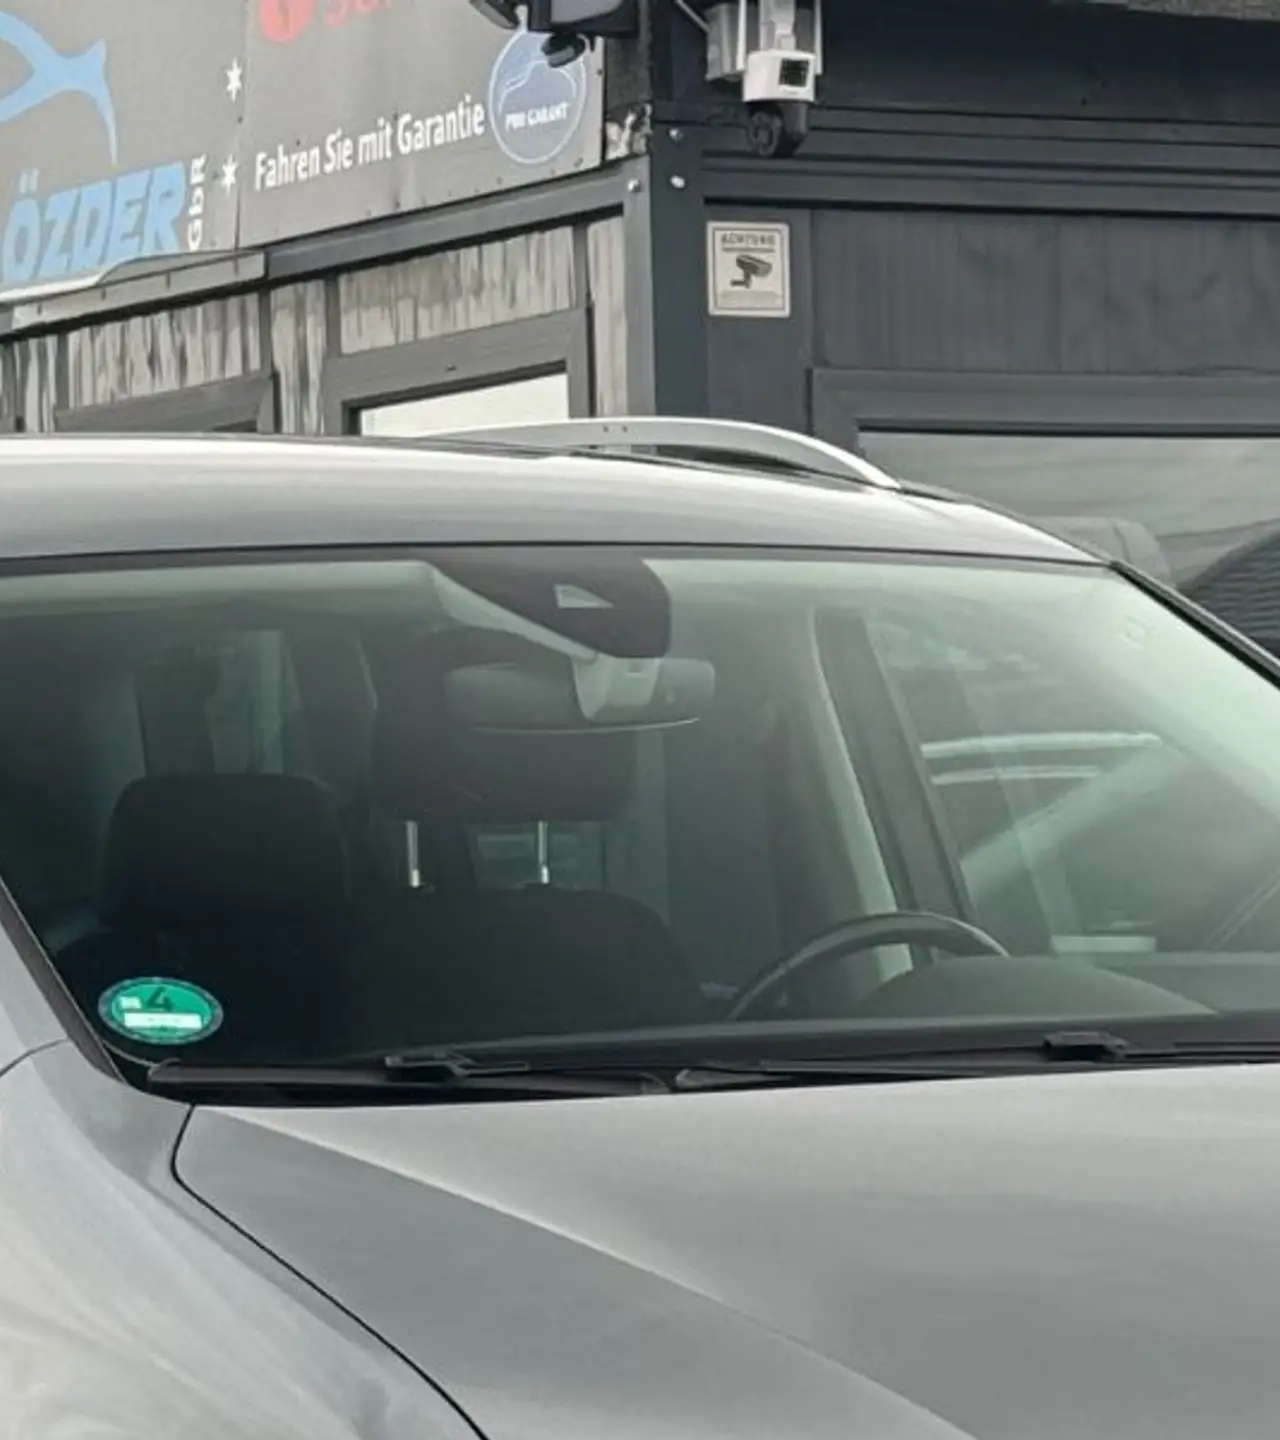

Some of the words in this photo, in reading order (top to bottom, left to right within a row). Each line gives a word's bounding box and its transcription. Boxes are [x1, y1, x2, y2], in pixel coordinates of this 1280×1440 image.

[255, 145, 320, 191] Fahren
[324, 129, 354, 174] Sie
[358, 117, 393, 165] mit
[397, 94, 486, 156] Garantie
